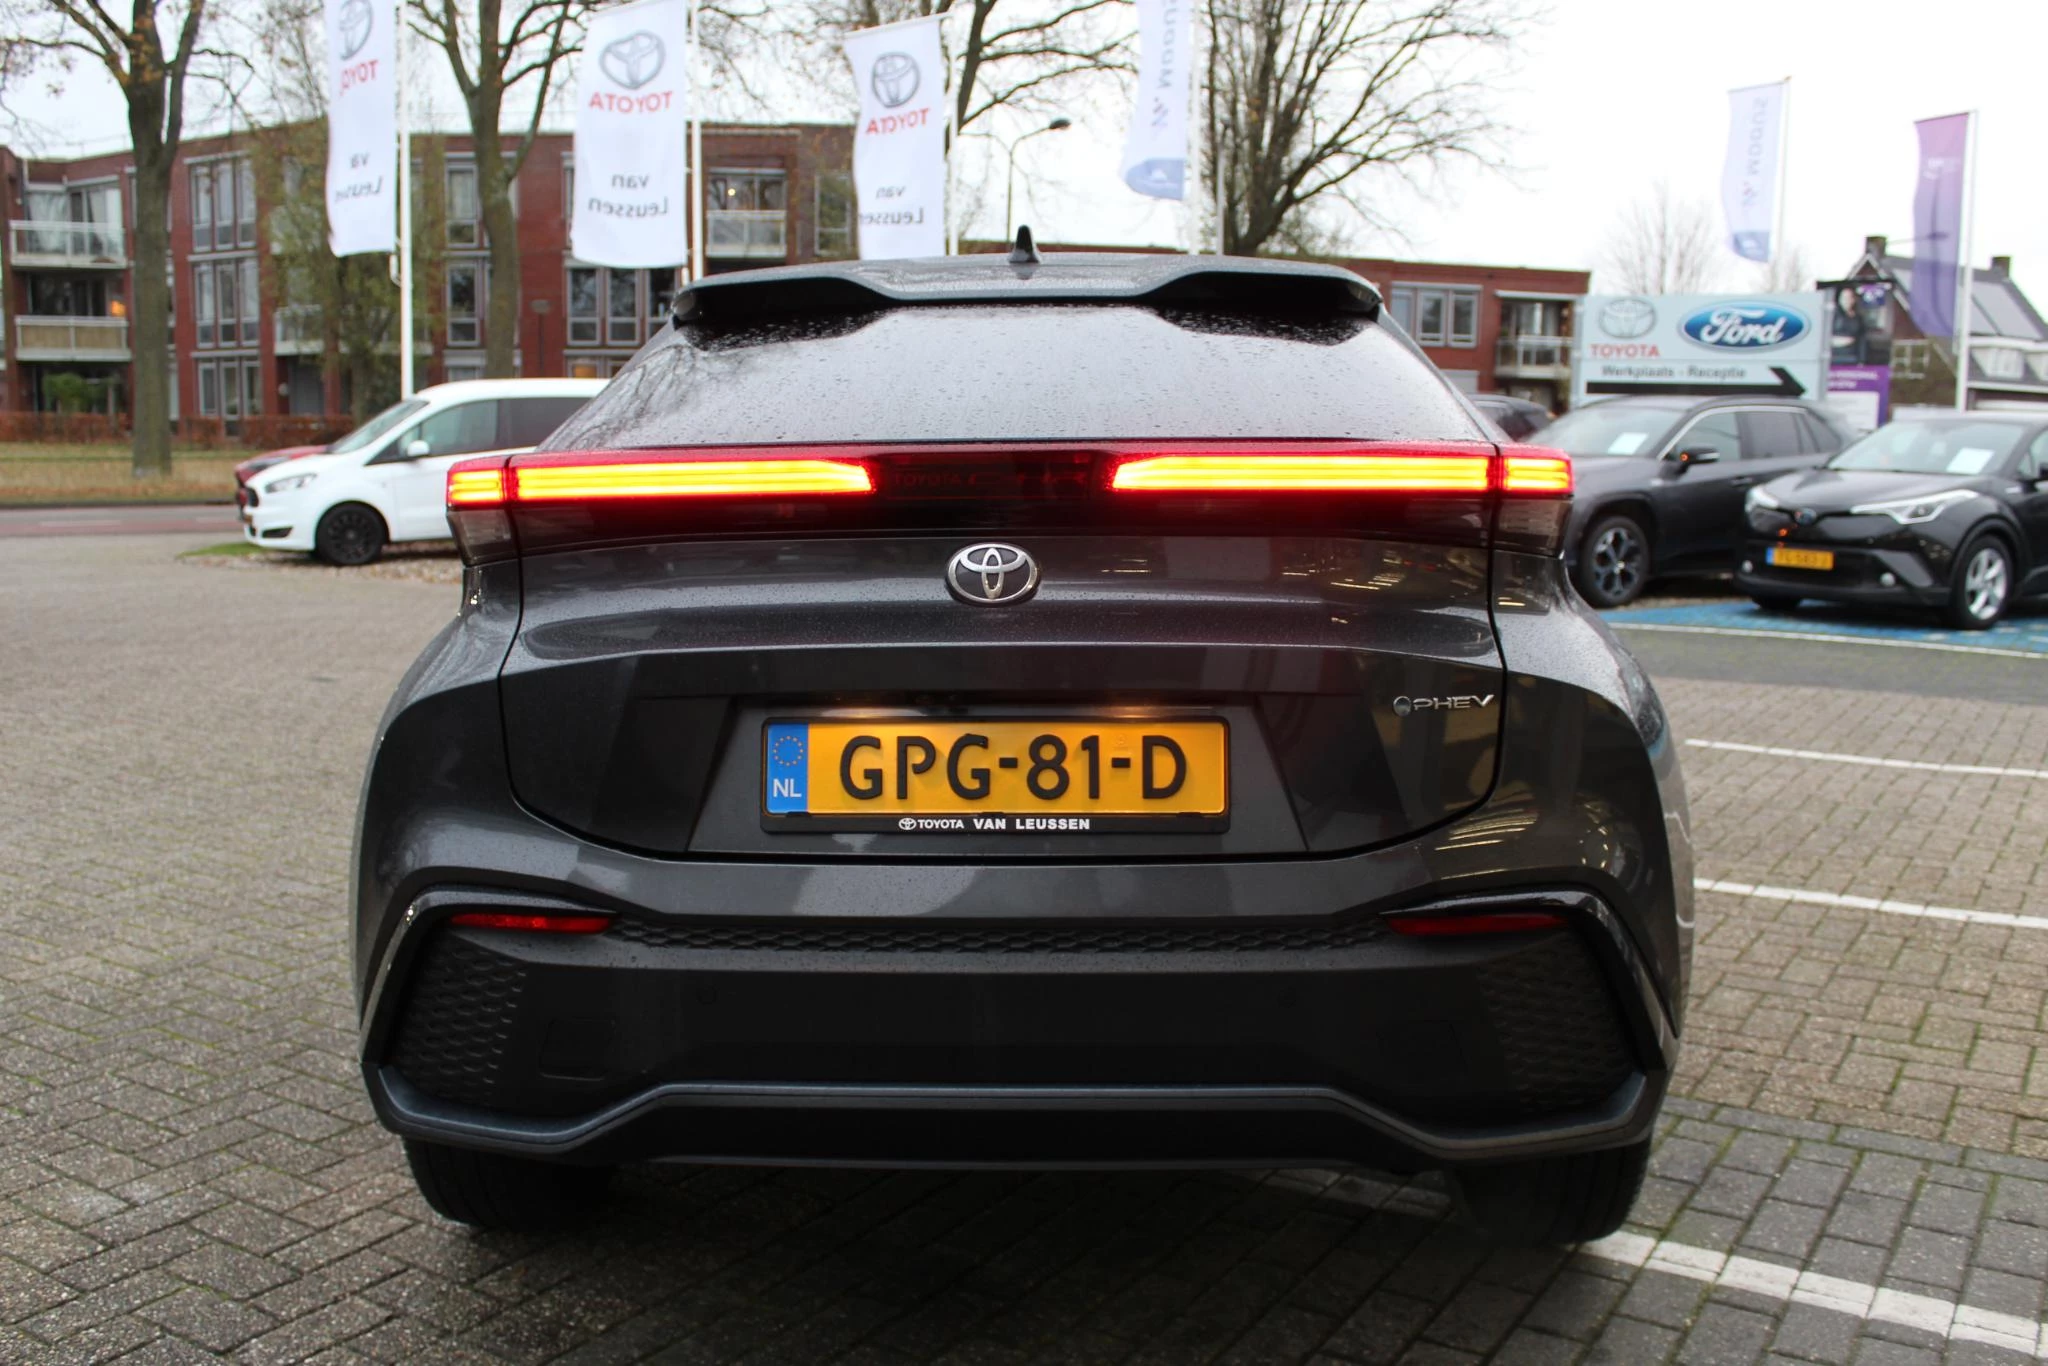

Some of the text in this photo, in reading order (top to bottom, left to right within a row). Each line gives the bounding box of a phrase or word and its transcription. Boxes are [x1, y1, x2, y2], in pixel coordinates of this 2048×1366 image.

[1701, 307, 1787, 345] Ford
[1591, 344, 1659, 357] TOYOTA
[1602, 365, 1675, 379] Werkplaats
[1687, 365, 1746, 379] Receptie
[1413, 695, 1494, 710] PHEV
[840, 734, 1186, 800] GPG-81-D
[773, 778, 801, 797] NL
[918, 818, 1090, 830] TOYOTA VAN LEUSSEN
